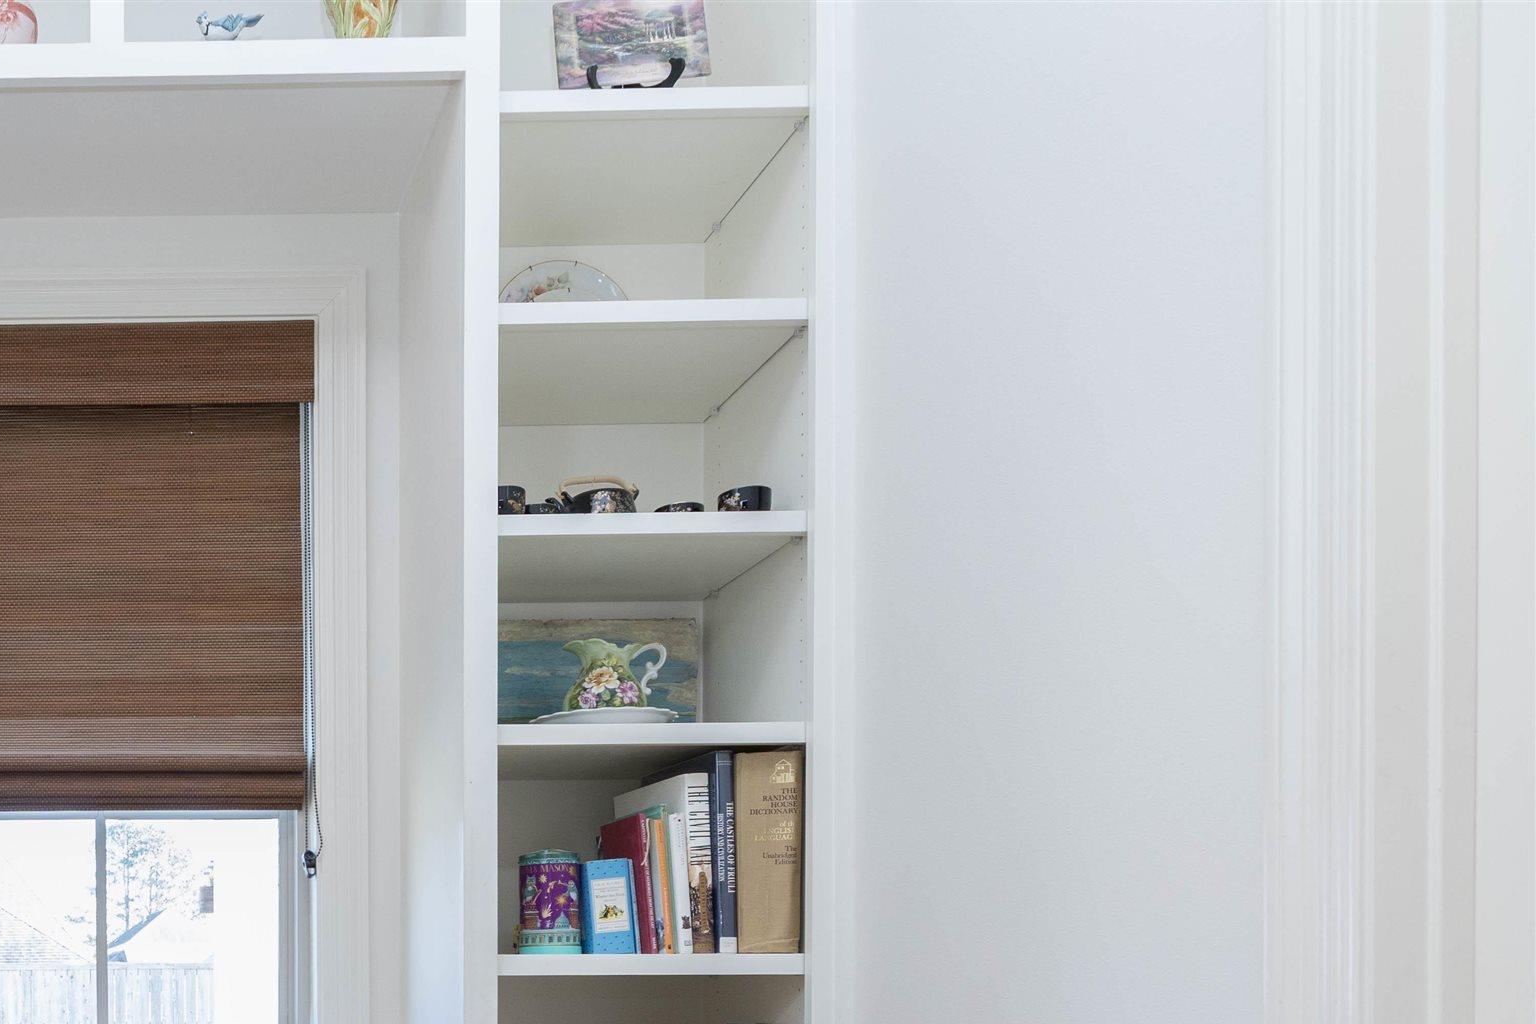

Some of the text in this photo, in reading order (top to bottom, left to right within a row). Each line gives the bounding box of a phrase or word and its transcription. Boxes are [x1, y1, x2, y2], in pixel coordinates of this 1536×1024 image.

[688, 785, 711, 866] THE CIVIL WAR
[750, 807, 798, 815] DICTIONARY
[717, 847, 725, 882] CIVILIZATION
[726, 801, 736, 893] THE CASTLES OF FRIULI
[540, 864, 569, 872] MASON
